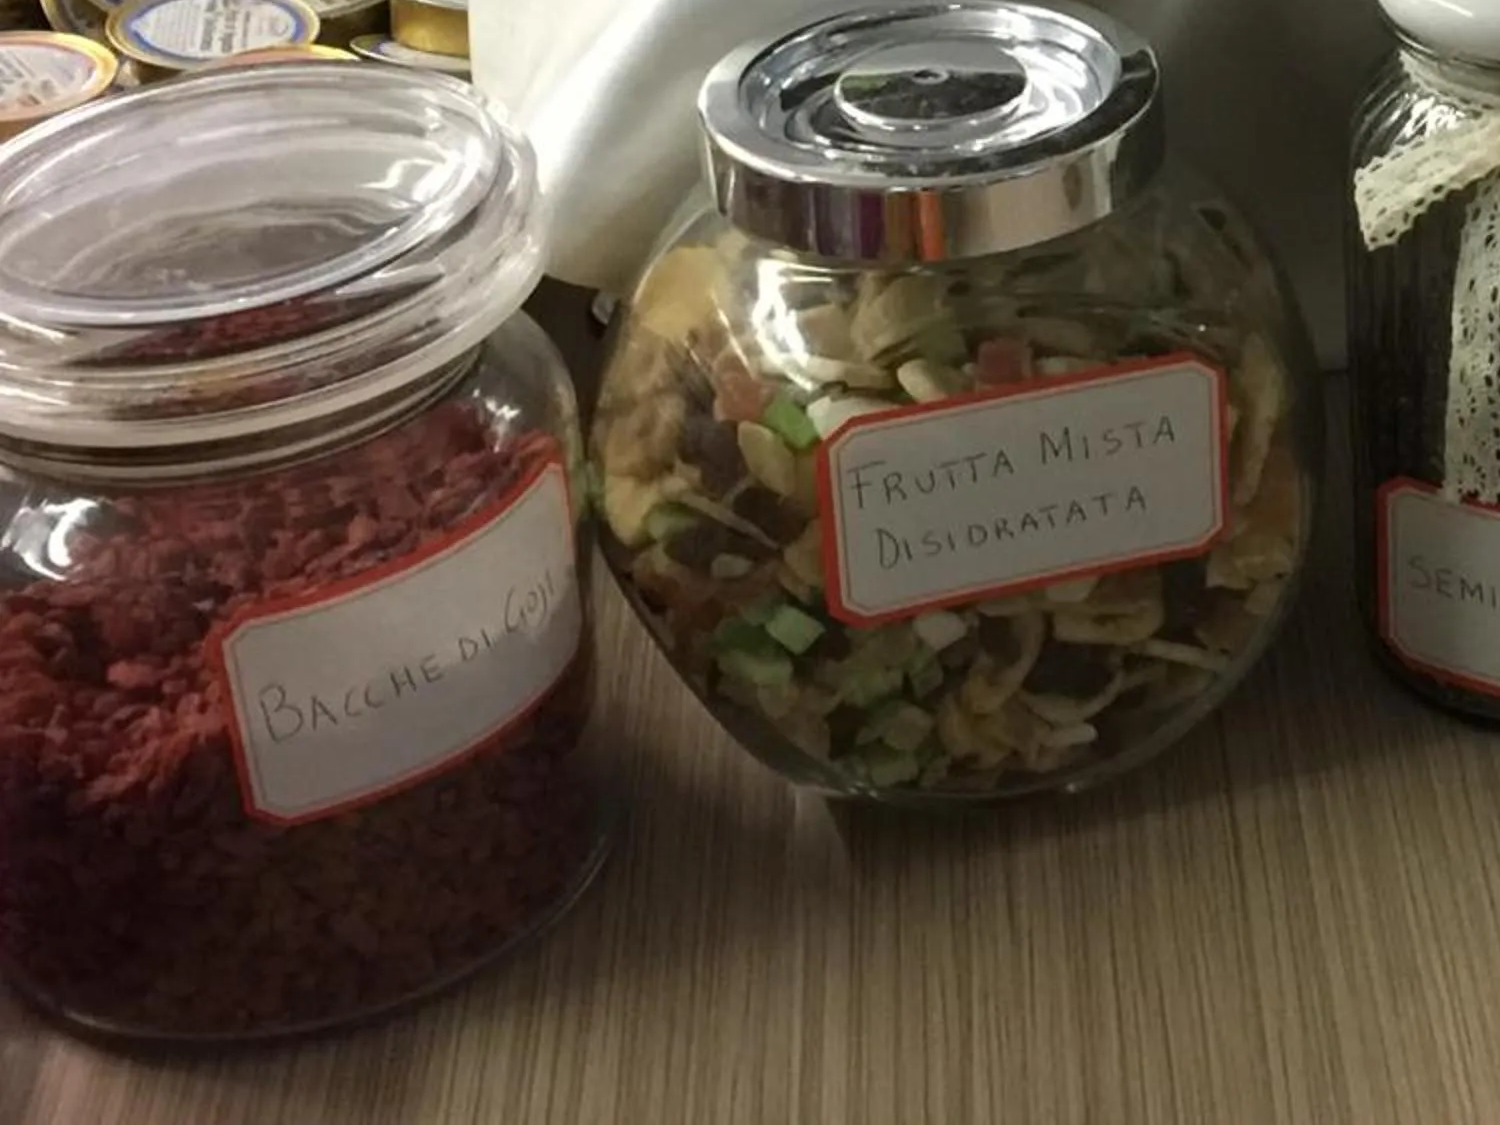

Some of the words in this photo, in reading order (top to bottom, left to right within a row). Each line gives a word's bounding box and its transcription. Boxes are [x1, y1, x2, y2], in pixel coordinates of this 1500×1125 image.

[846, 448, 1015, 509] FRUTTA
[1039, 414, 1176, 464] MISTA
[875, 485, 1147, 569] DISIDRATATA
[1408, 555, 1498, 611] SEMI
[259, 653, 446, 744] BACCHE
[458, 628, 492, 663] DI
